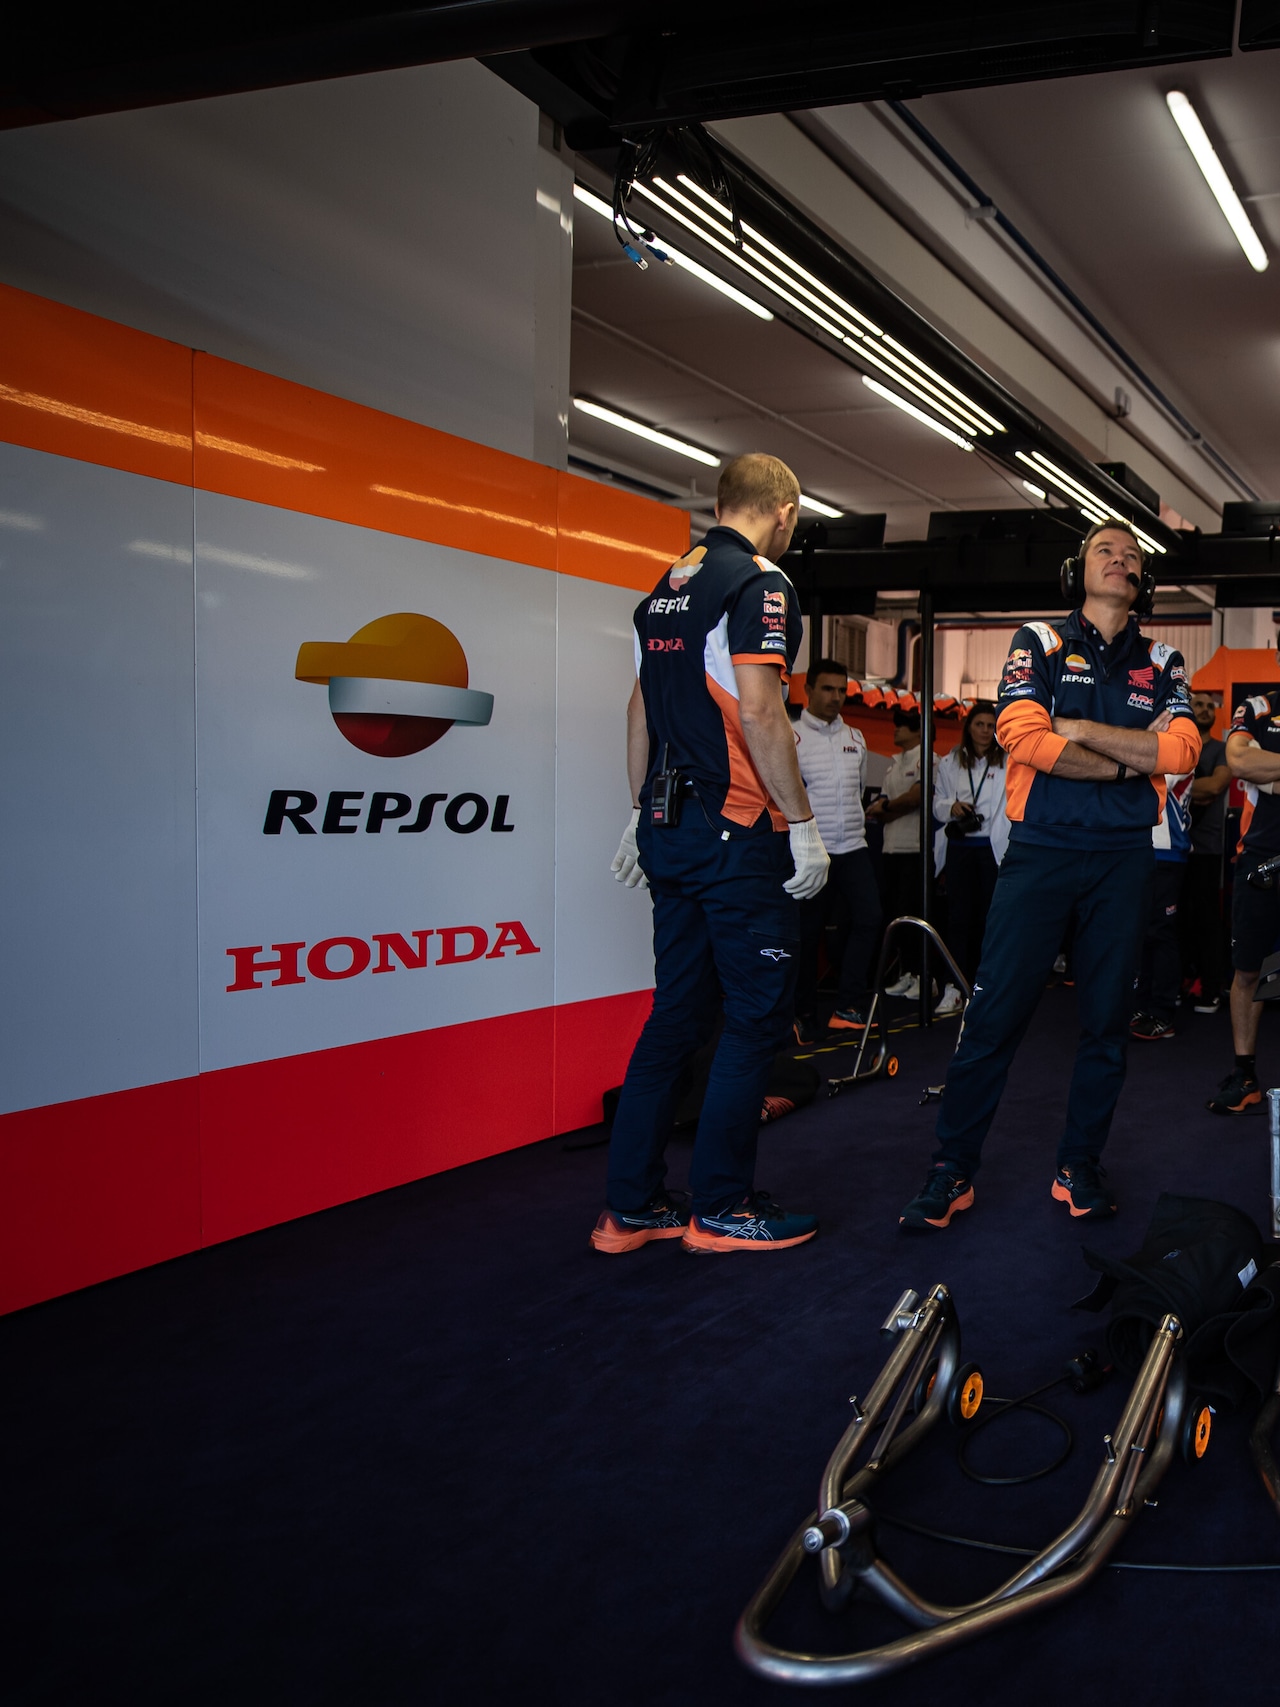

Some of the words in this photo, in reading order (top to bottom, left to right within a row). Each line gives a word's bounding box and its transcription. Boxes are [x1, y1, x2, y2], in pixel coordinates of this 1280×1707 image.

[1061, 674, 1095, 685] REPSOL
[263, 789, 515, 835] REPSOL
[226, 921, 541, 993] HONDA
